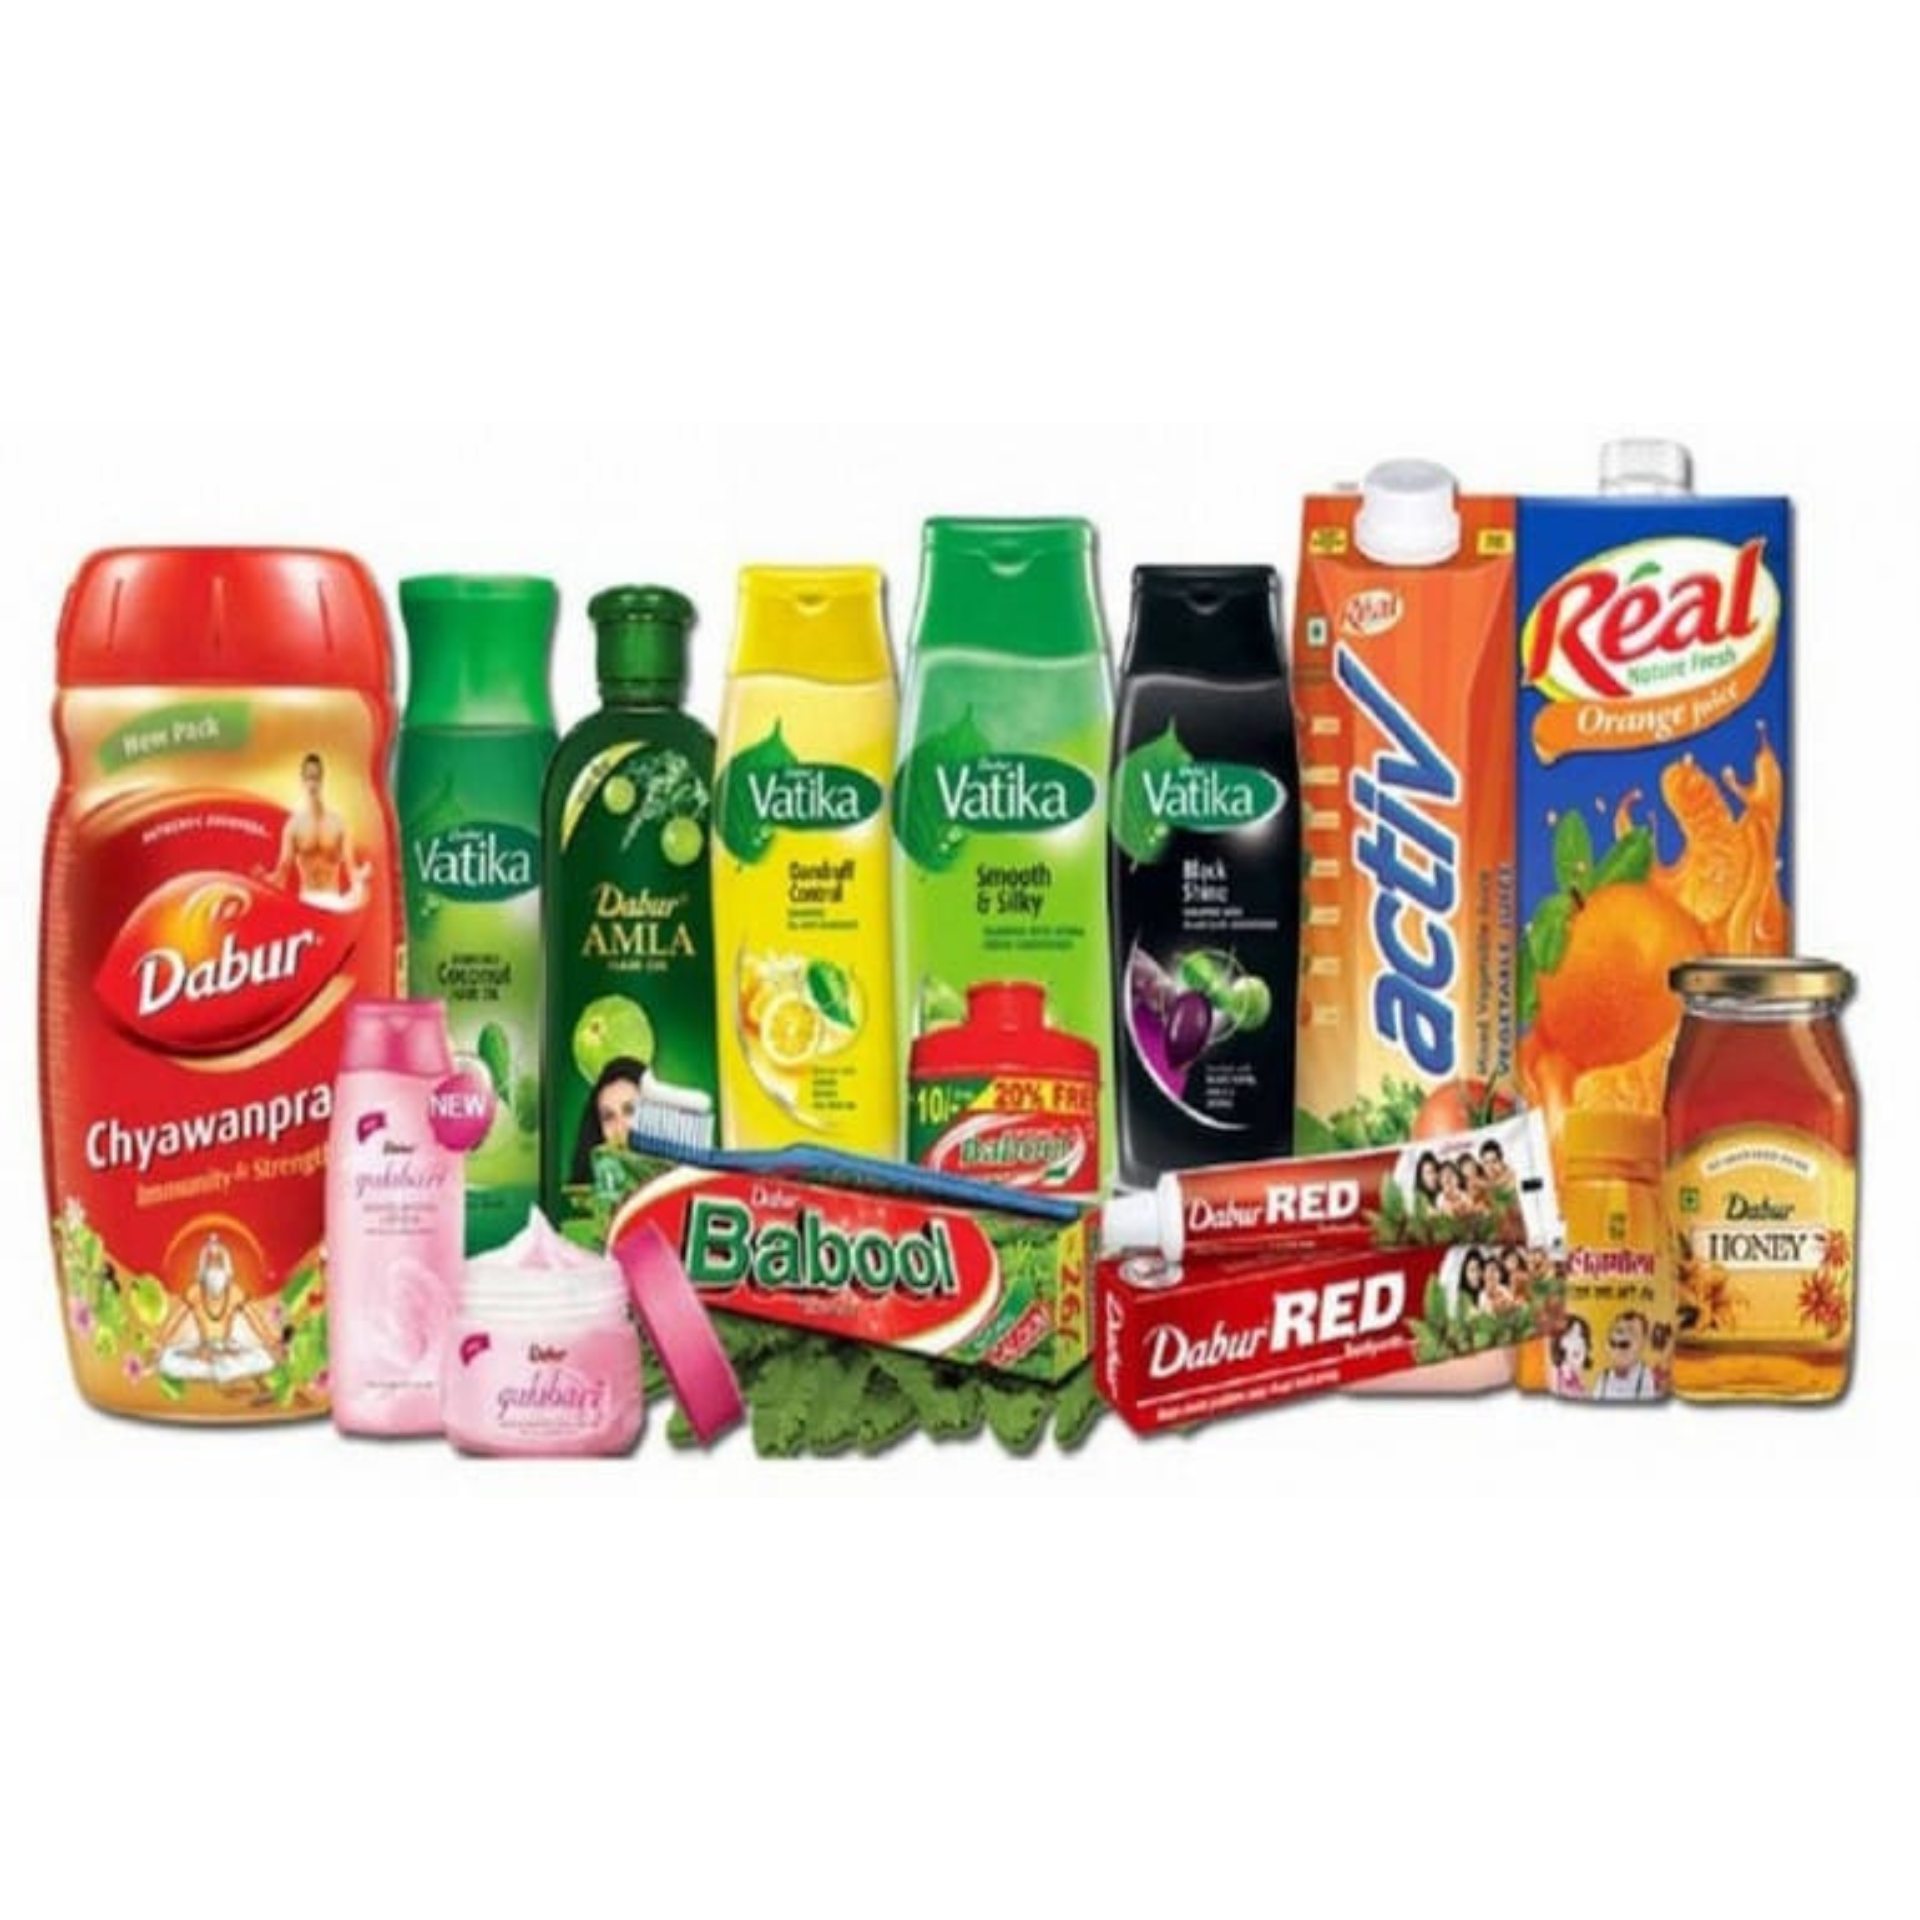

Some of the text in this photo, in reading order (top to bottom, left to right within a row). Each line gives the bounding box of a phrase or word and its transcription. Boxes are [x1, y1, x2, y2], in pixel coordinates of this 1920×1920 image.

[122, 714, 220, 758] New Pack
[1577, 702, 1684, 742] Orange
[747, 770, 861, 821] Vatika
[936, 762, 1070, 821] Vatika
[1141, 768, 1255, 818] Vatika
[414, 831, 531, 886] Vatika
[1333, 641, 1461, 1079] activ
[592, 881, 681, 919] Dabur
[582, 922, 696, 957] AMLA
[132, 930, 316, 1017] Dabur
[85, 1083, 334, 1172] Chyawanpra
[430, 1093, 485, 1120] NEW
[1186, 1179, 1361, 1231] Dabur RED
[1725, 1192, 1796, 1221] Dabur
[687, 1194, 960, 1295] Babool
[1708, 1233, 1807, 1262] HONEY
[1142, 1271, 1407, 1379] Dabur RED
